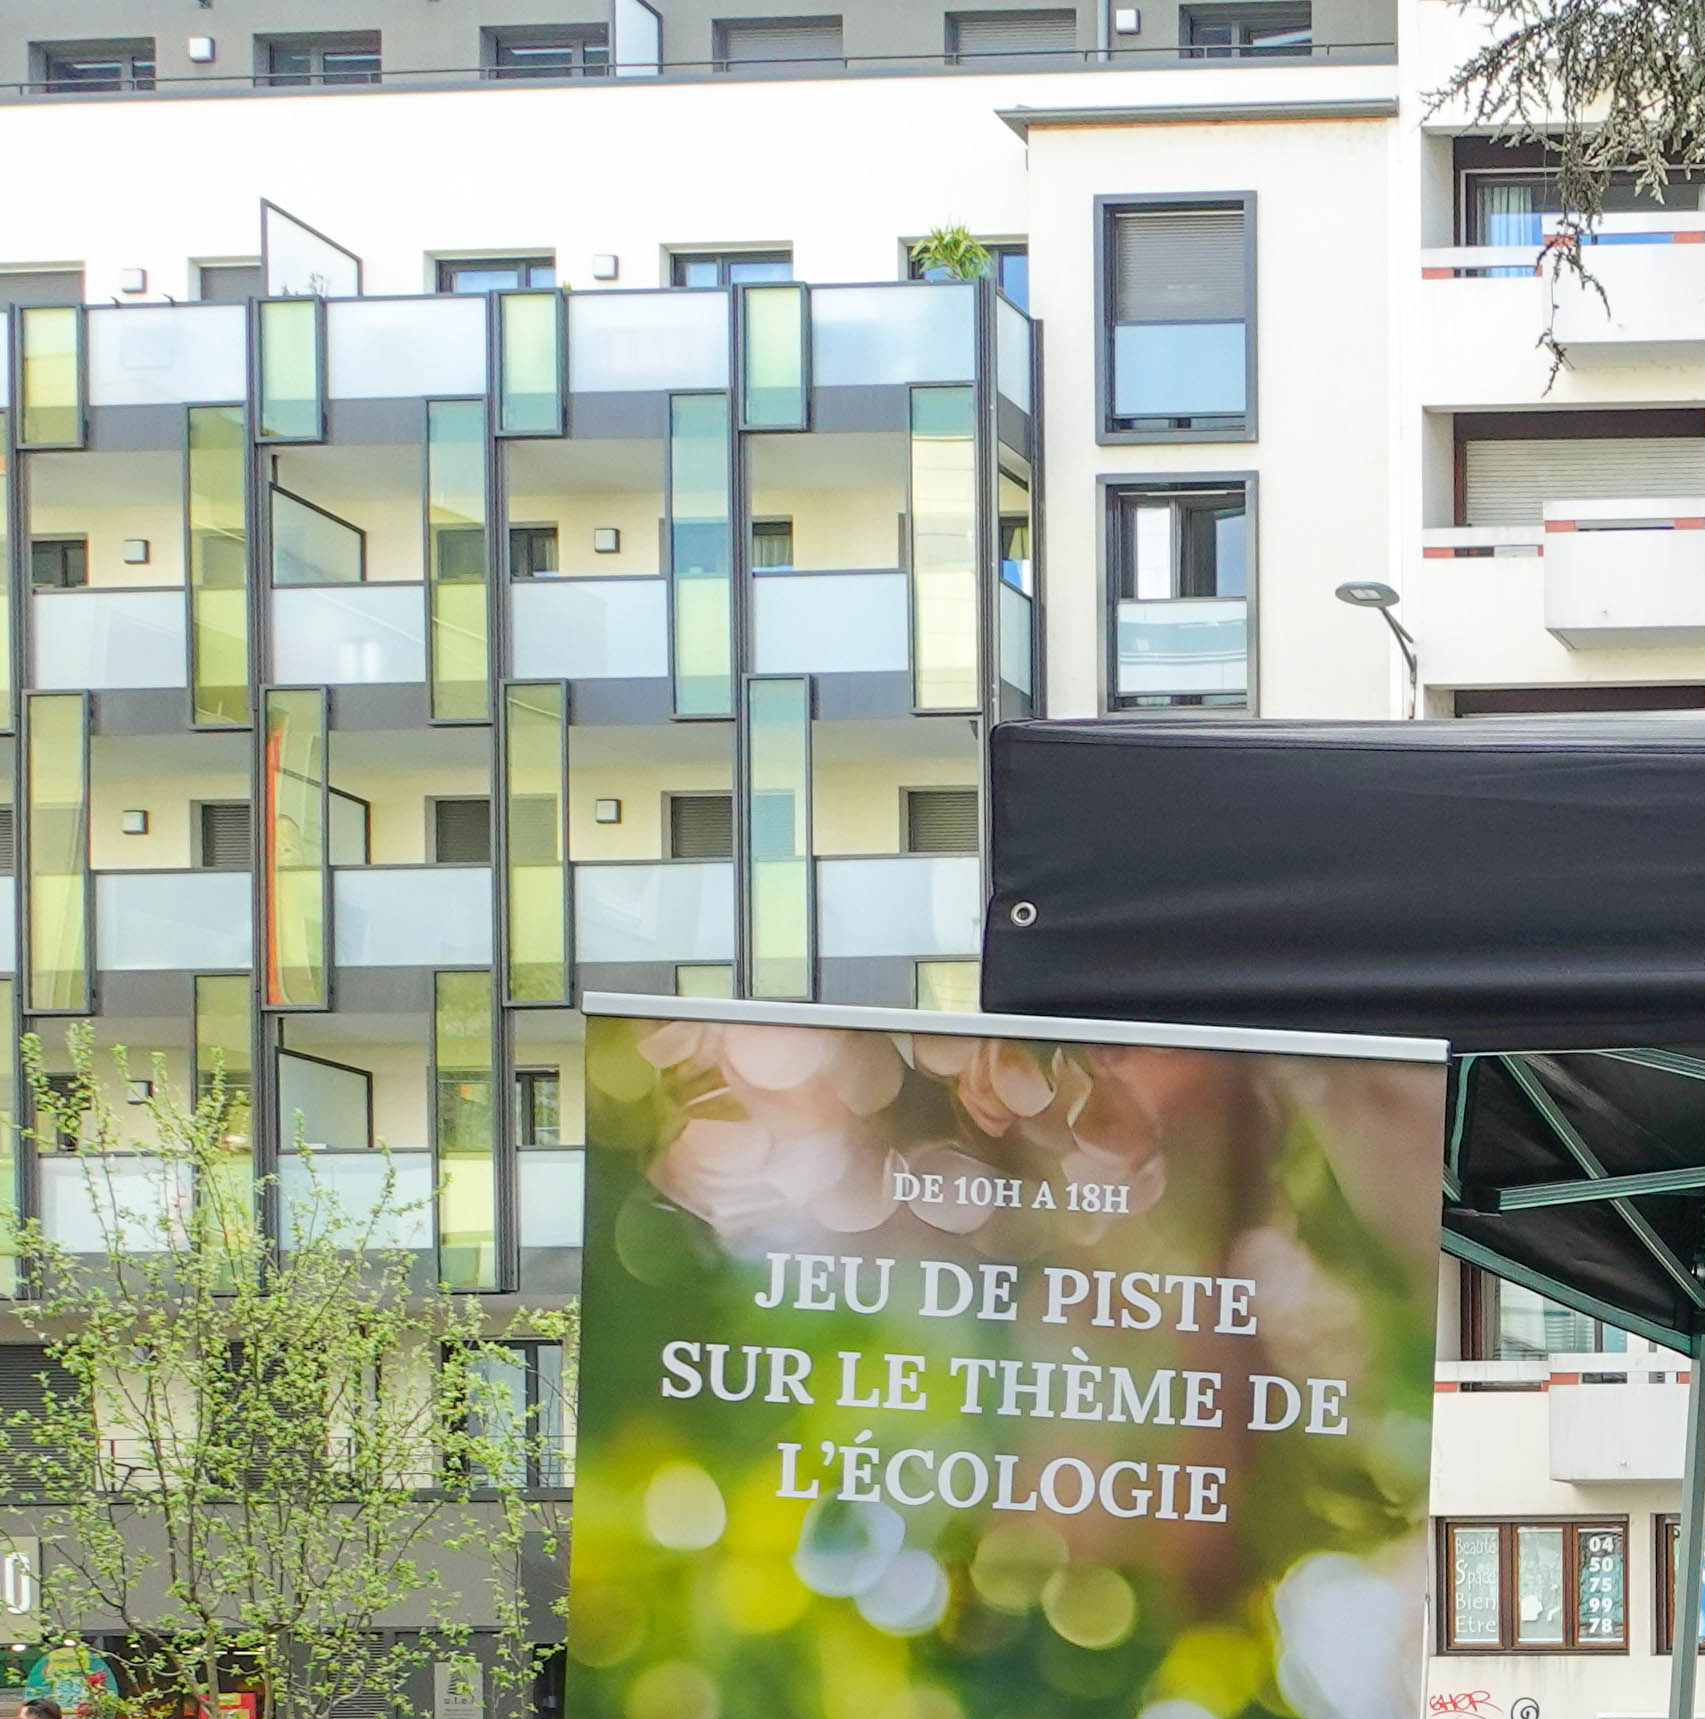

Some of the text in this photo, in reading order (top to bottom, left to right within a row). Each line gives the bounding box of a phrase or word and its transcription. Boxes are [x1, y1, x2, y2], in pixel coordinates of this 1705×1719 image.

[892, 1172, 1131, 1214] DE 10H A 18H
[754, 1251, 1259, 1335] JEU DE PISTE
[660, 1341, 1350, 1436] SUR LE THÈME DE
[775, 1430, 1229, 1523] L'ÉCOLOGIE
[1588, 1537, 1614, 1552] 04
[1588, 1557, 1614, 1572] 50
[1589, 1578, 1613, 1592] 75
[1455, 1592, 1497, 1611] Bien
[1588, 1598, 1613, 1612] 99
[1455, 1615, 1497, 1634] Etre
[1589, 1618, 1613, 1633] 78
